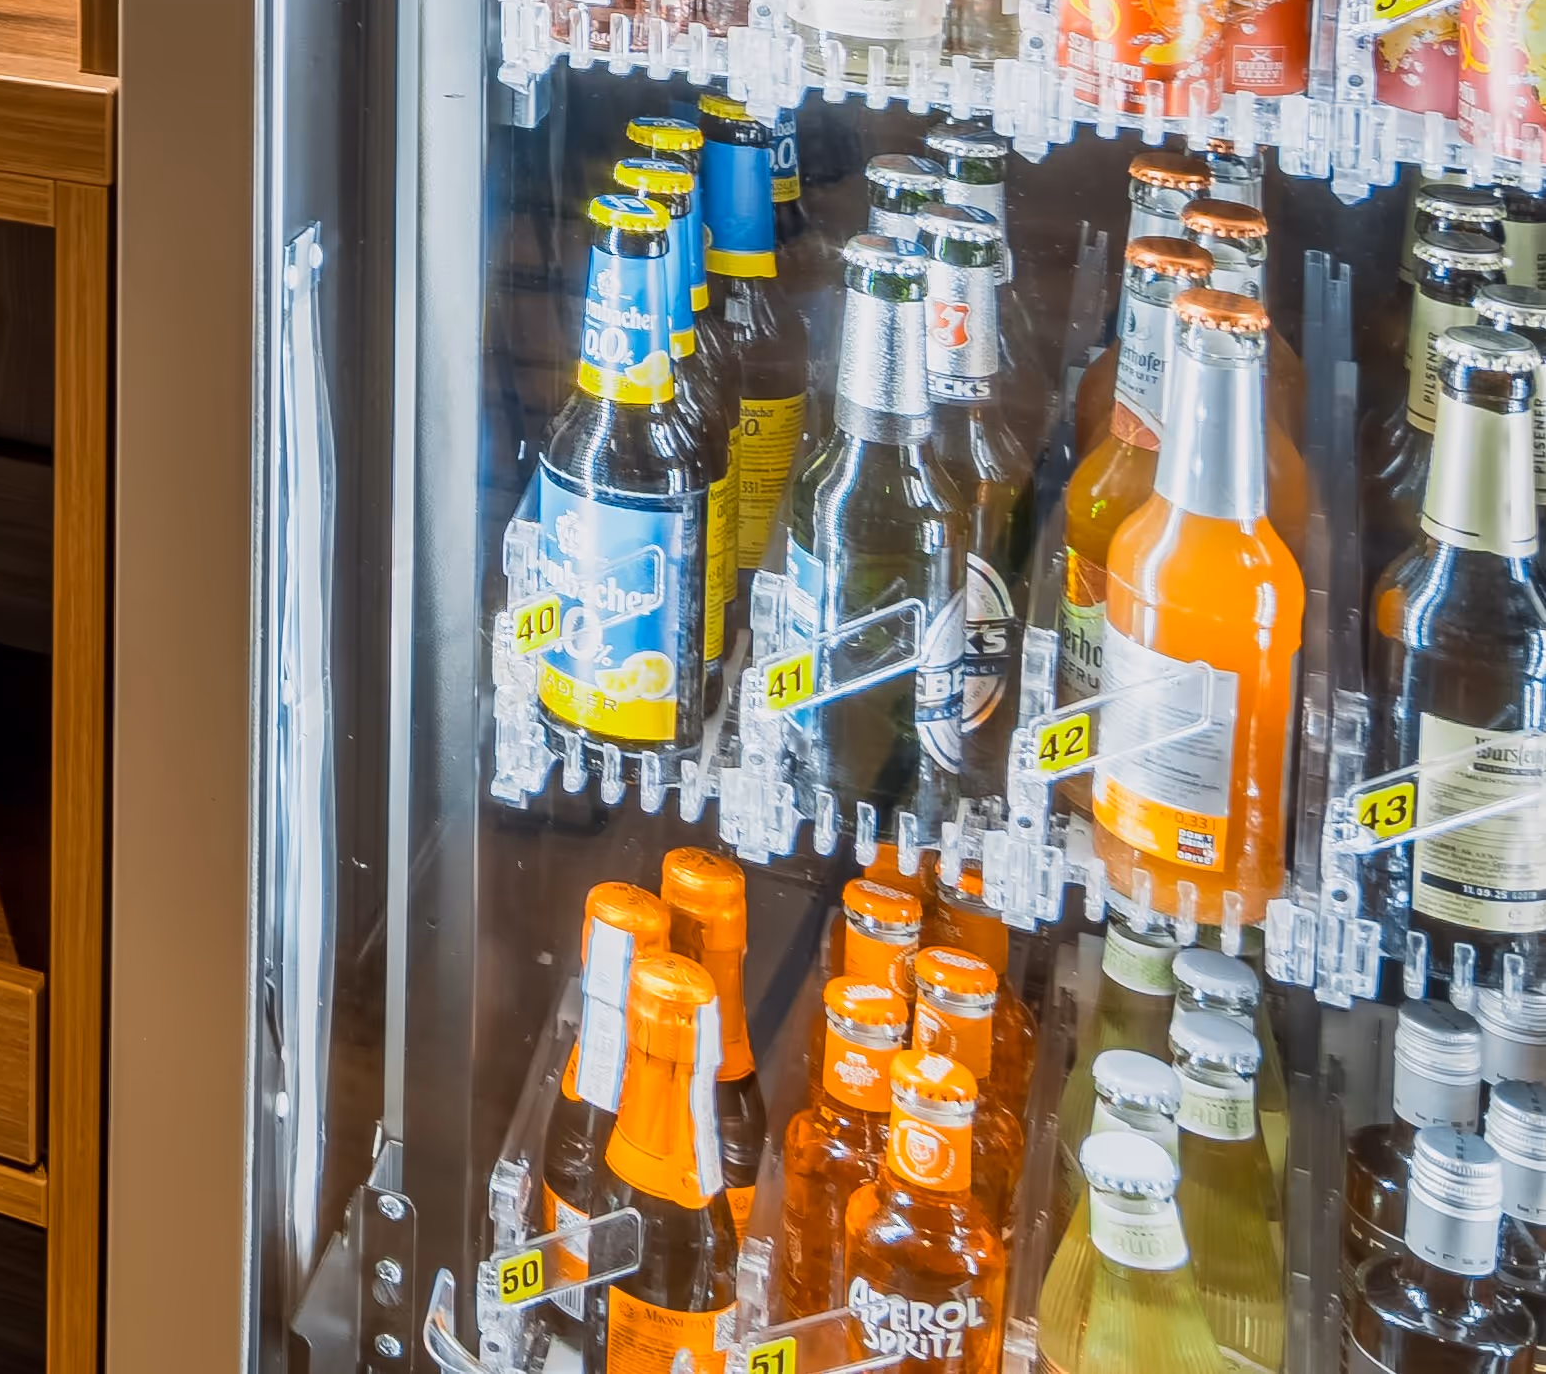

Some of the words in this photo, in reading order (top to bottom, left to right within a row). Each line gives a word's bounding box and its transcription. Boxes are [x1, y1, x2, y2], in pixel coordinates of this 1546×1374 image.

[1423, 331, 1439, 405] PILSENER
[1533, 397, 1544, 475] PILSENER
[516, 606, 555, 643] 40
[544, 676, 618, 713] ADLER
[768, 663, 803, 700] 41
[1038, 725, 1085, 763] 42
[1174, 810, 1208, 830] 0,33
[1361, 794, 1408, 831] 43
[503, 1259, 539, 1295] 50
[848, 1276, 985, 1334] APEROL
[863, 1321, 964, 1361] SPRITZ
[751, 1348, 784, 1374] 51
